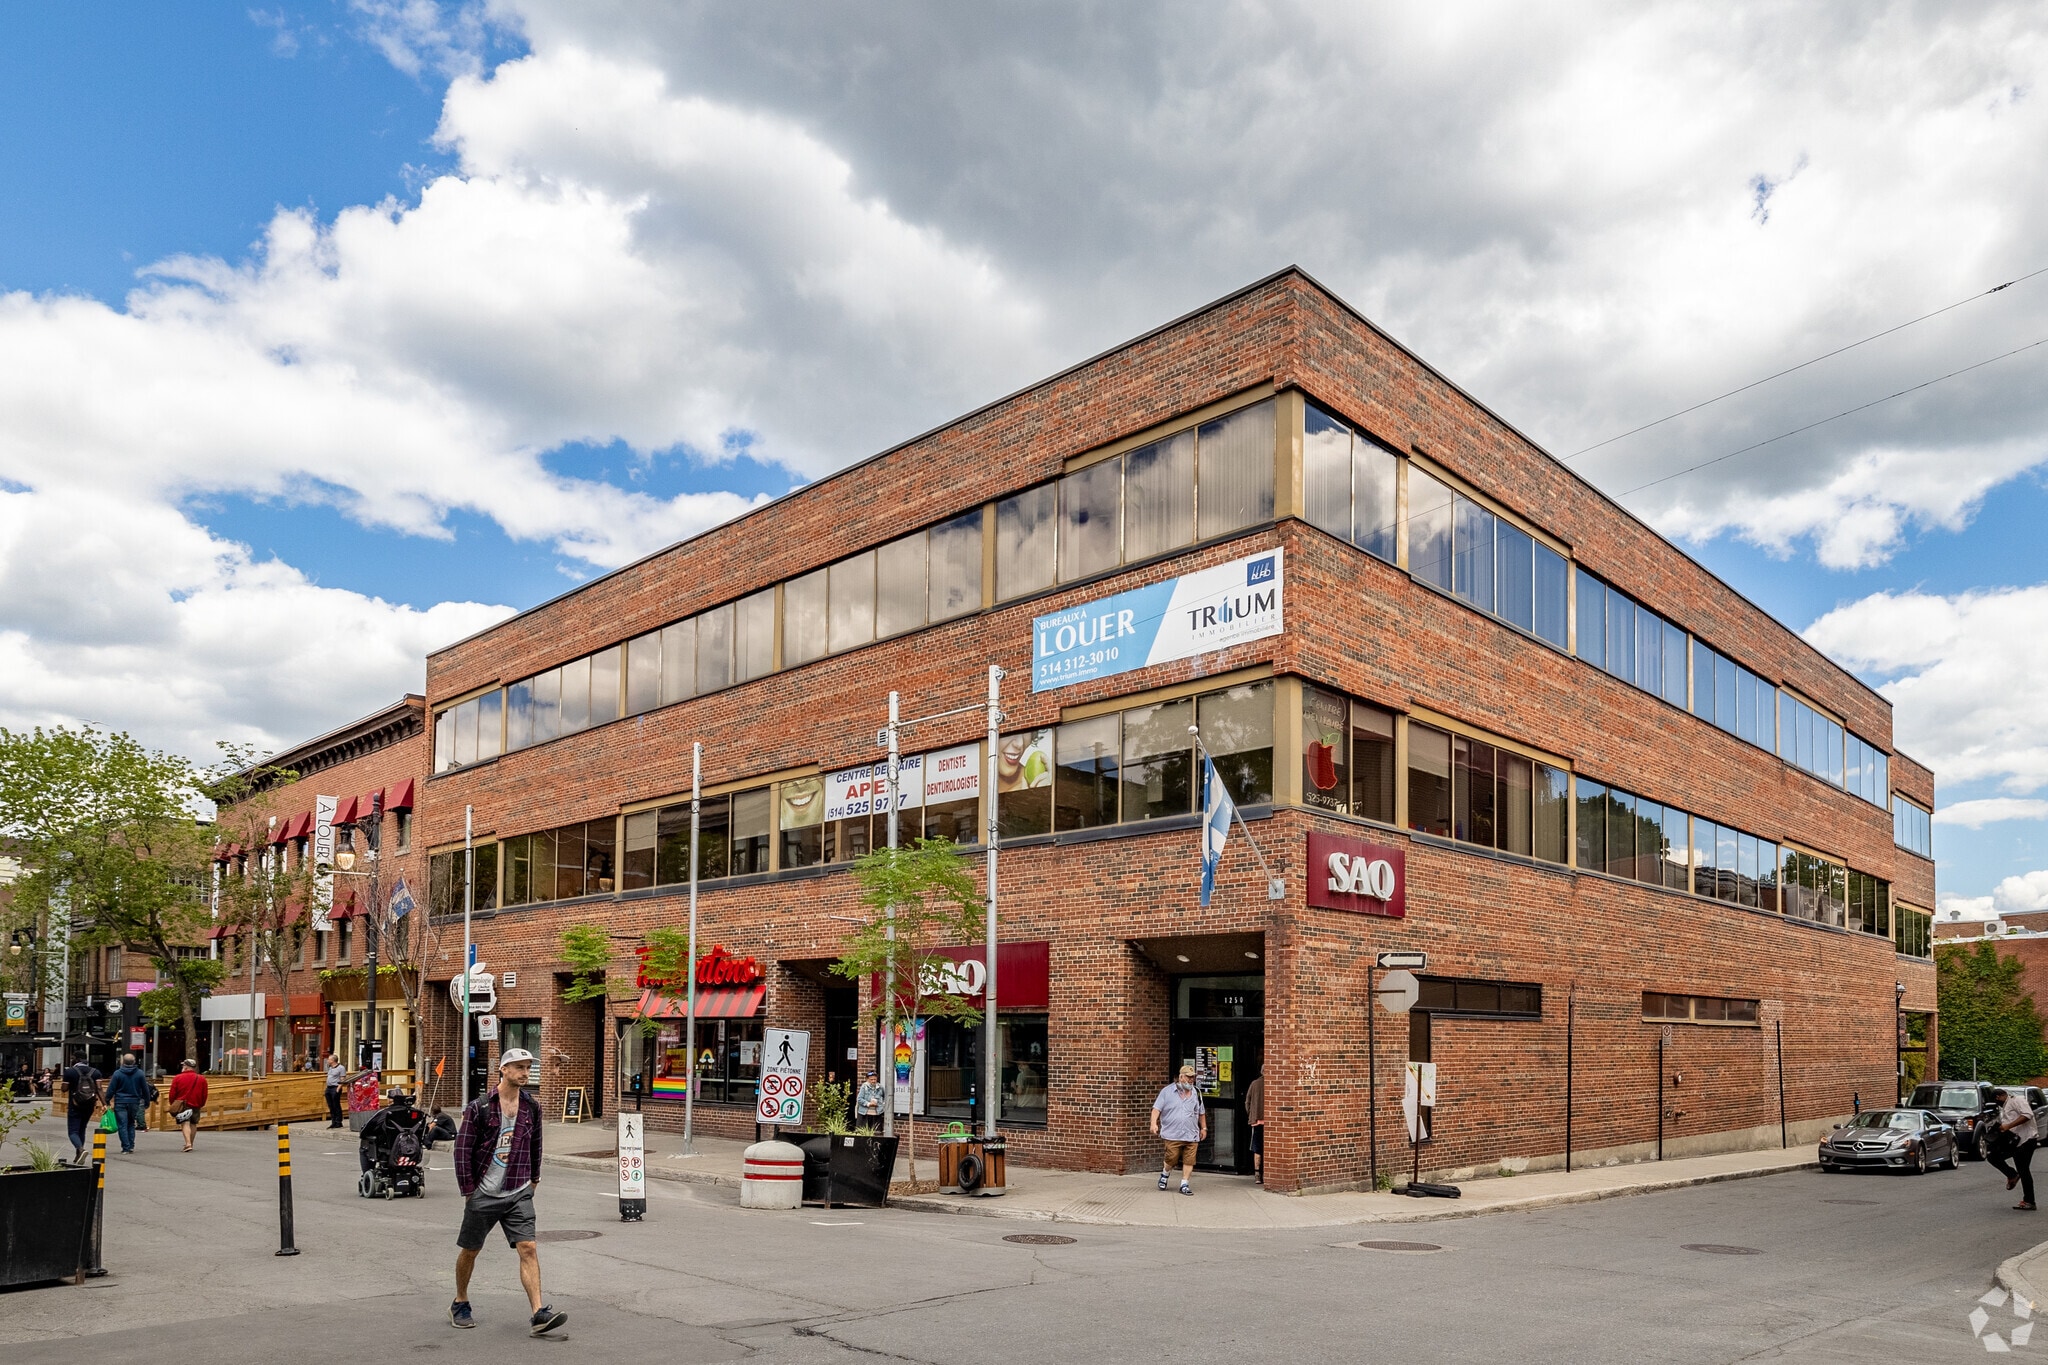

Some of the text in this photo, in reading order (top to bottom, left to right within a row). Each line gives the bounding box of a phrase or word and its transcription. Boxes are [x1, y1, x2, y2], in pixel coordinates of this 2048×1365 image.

[1040, 608, 1087, 630] BUREAUX À
[1187, 588, 1275, 631] TRIUM
[1040, 609, 1136, 657] LOUER
[1192, 613, 1275, 640] IMMOBILIER
[1040, 646, 1119, 677] 514 312-3010
[1040, 667, 1098, 685] www.trium.immo
[836, 757, 921, 784] CENTRE DEAIRE
[938, 755, 967, 772] DENTISTE
[845, 779, 889, 800] APE
[926, 774, 978, 796] DENTUROLOGISTE
[319, 801, 335, 815] À
[827, 794, 908, 819] (514) 525 977
[316, 819, 331, 859] LOUER
[1328, 852, 1396, 901] SAQ
[918, 959, 988, 997] SAQ
[1224, 996, 1244, 1004] 1250
